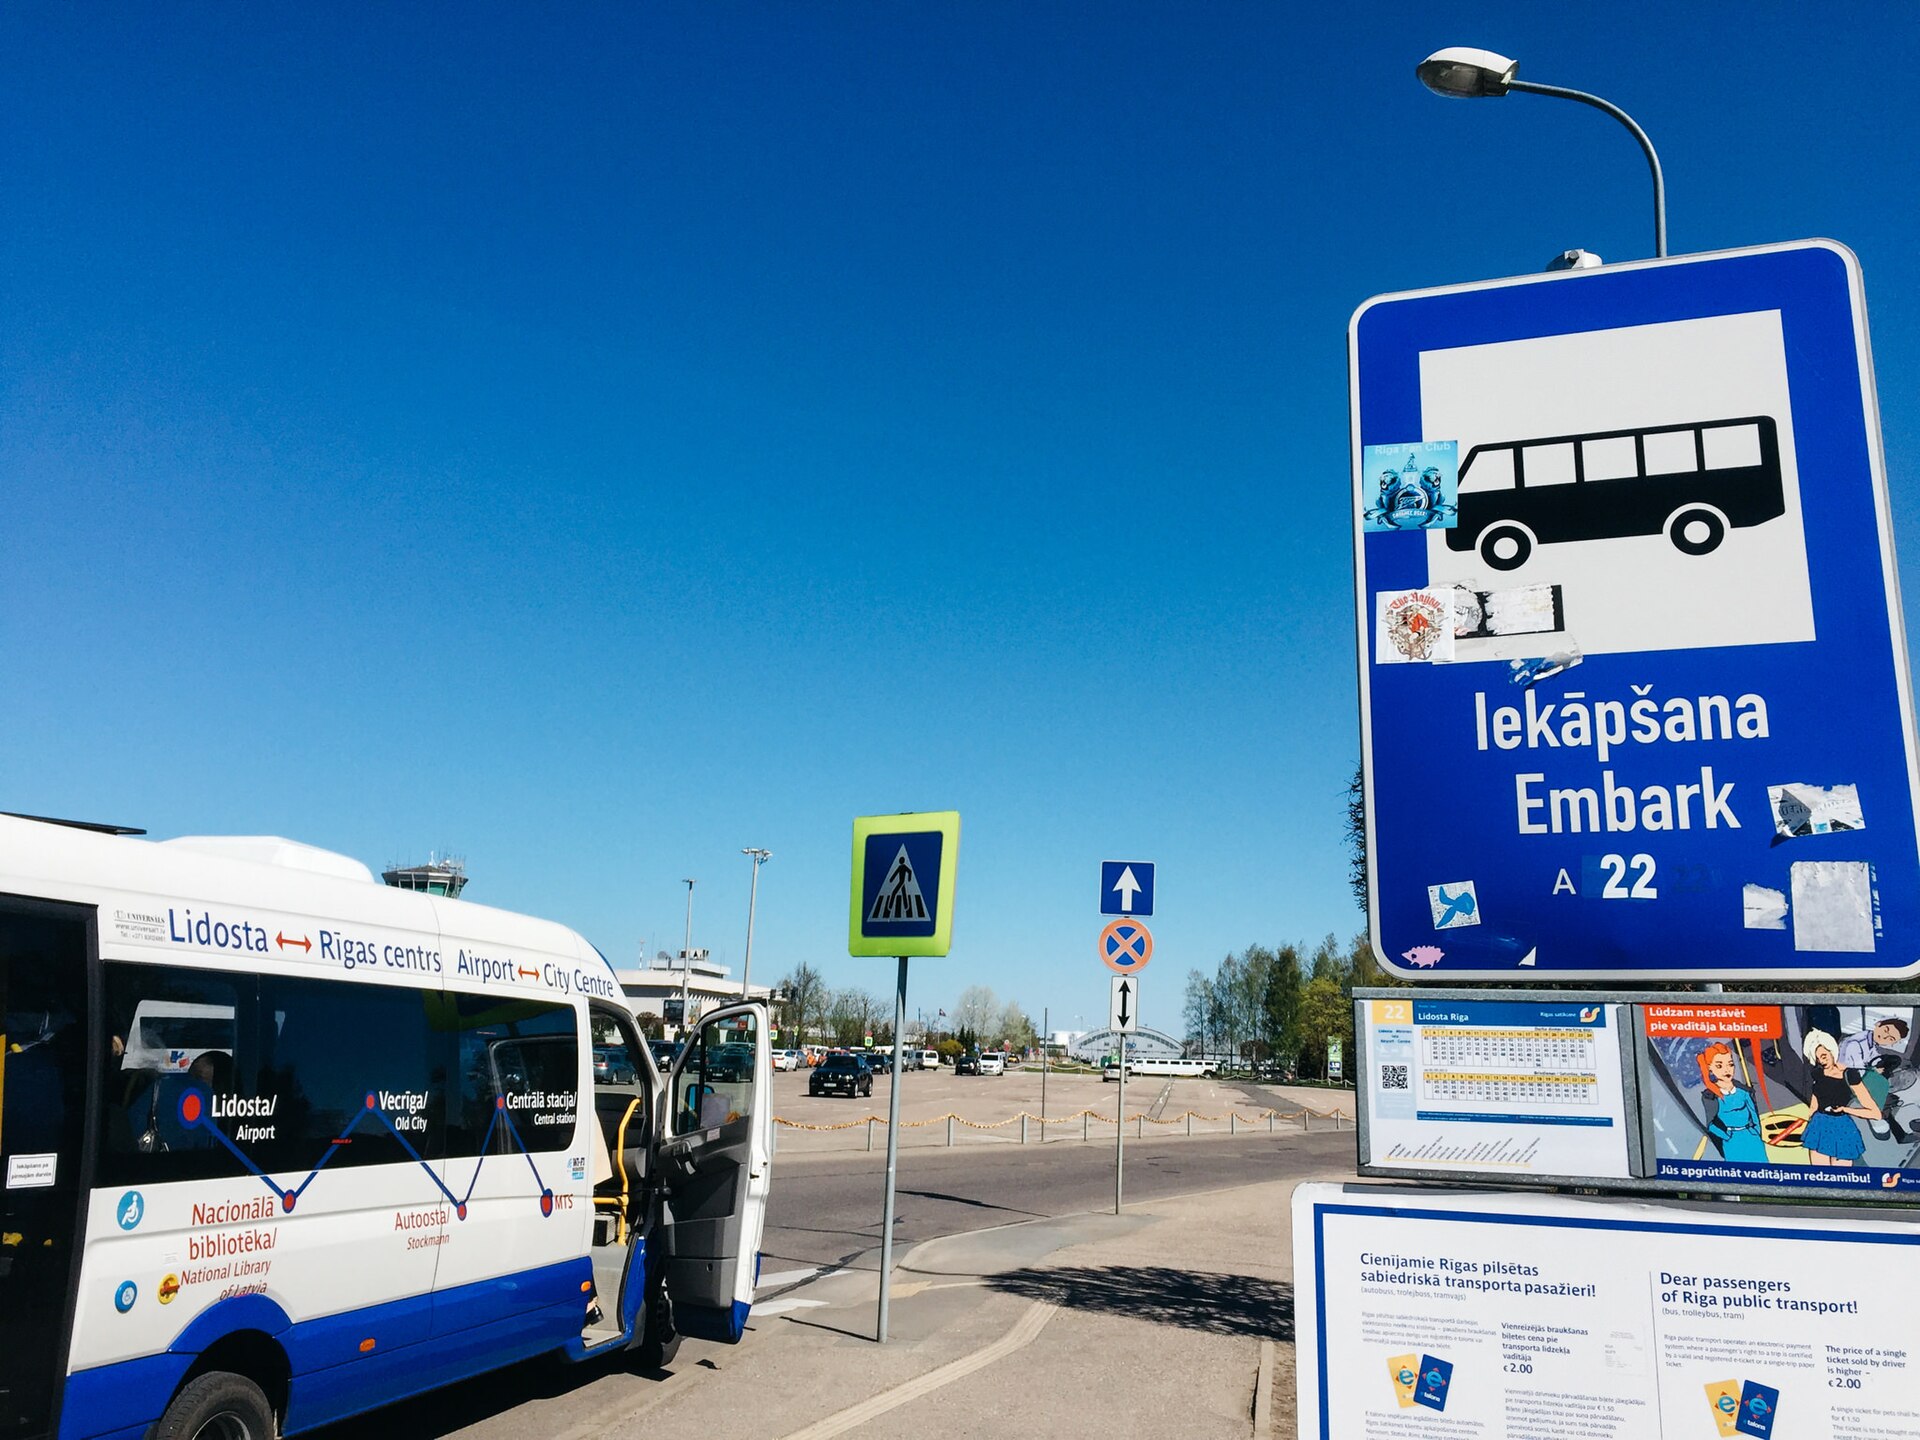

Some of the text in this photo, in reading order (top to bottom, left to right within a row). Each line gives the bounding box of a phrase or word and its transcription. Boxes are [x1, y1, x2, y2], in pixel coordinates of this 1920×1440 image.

[1425, 442, 1450, 451] Club
[1475, 684, 1770, 762] Iekāpšana
[1515, 766, 1742, 834] Embark
[1553, 854, 1657, 899] A 22
[169, 909, 441, 972] Lidosta Rīgas centrs
[458, 949, 614, 997] Airport City Centre
[1384, 1005, 1405, 1019] 22
[1649, 1007, 1746, 1018] Lūdzam nestāvēt
[1650, 1021, 1768, 1033] pie vadītāja kabīnes!
[212, 1094, 277, 1117] Lidosta/
[379, 1091, 429, 1115] Vecrīga/
[506, 1091, 577, 1111] Centrālā stacija/
[395, 1115, 427, 1133] Old City
[534, 1112, 576, 1125] Central station
[236, 1124, 275, 1144] Airport
[1661, 1165, 1871, 1184] Jūs apgrūtināt vadītājam redzamību!
[192, 1196, 274, 1226] Nacionālā
[555, 1194, 573, 1210] MTS
[395, 1206, 450, 1230] Autoosta/
[189, 1228, 277, 1260] bibliotēka/
[407, 1234, 450, 1250] Stockmann
[181, 1260, 271, 1286] National Library
[1360, 1253, 1539, 1277] Cienījamie Rīgas pilsētas
[220, 1280, 267, 1300] of Latvia
[1361, 1270, 1596, 1297] sabiedriskā transporta pasažieri!
[1661, 1272, 1791, 1294] Dear passengers
[1662, 1290, 1858, 1315] of Riga public transport!
[1547, 1326, 1588, 1335] braukšanas
[1502, 1343, 1540, 1352] transporta
[1826, 1345, 1840, 1353] The
[1843, 1347, 1862, 1355] price
[1883, 1350, 1907, 1359] single
[1510, 1363, 1533, 1374] 2.00
[1826, 1356, 1849, 1364] ticket
[1870, 1359, 1880, 1367] by
[1882, 1360, 1906, 1368] driver
[1828, 1366, 1834, 1374] is
[1836, 1367, 1862, 1376] higher
[1836, 1378, 1861, 1389] 2.00
